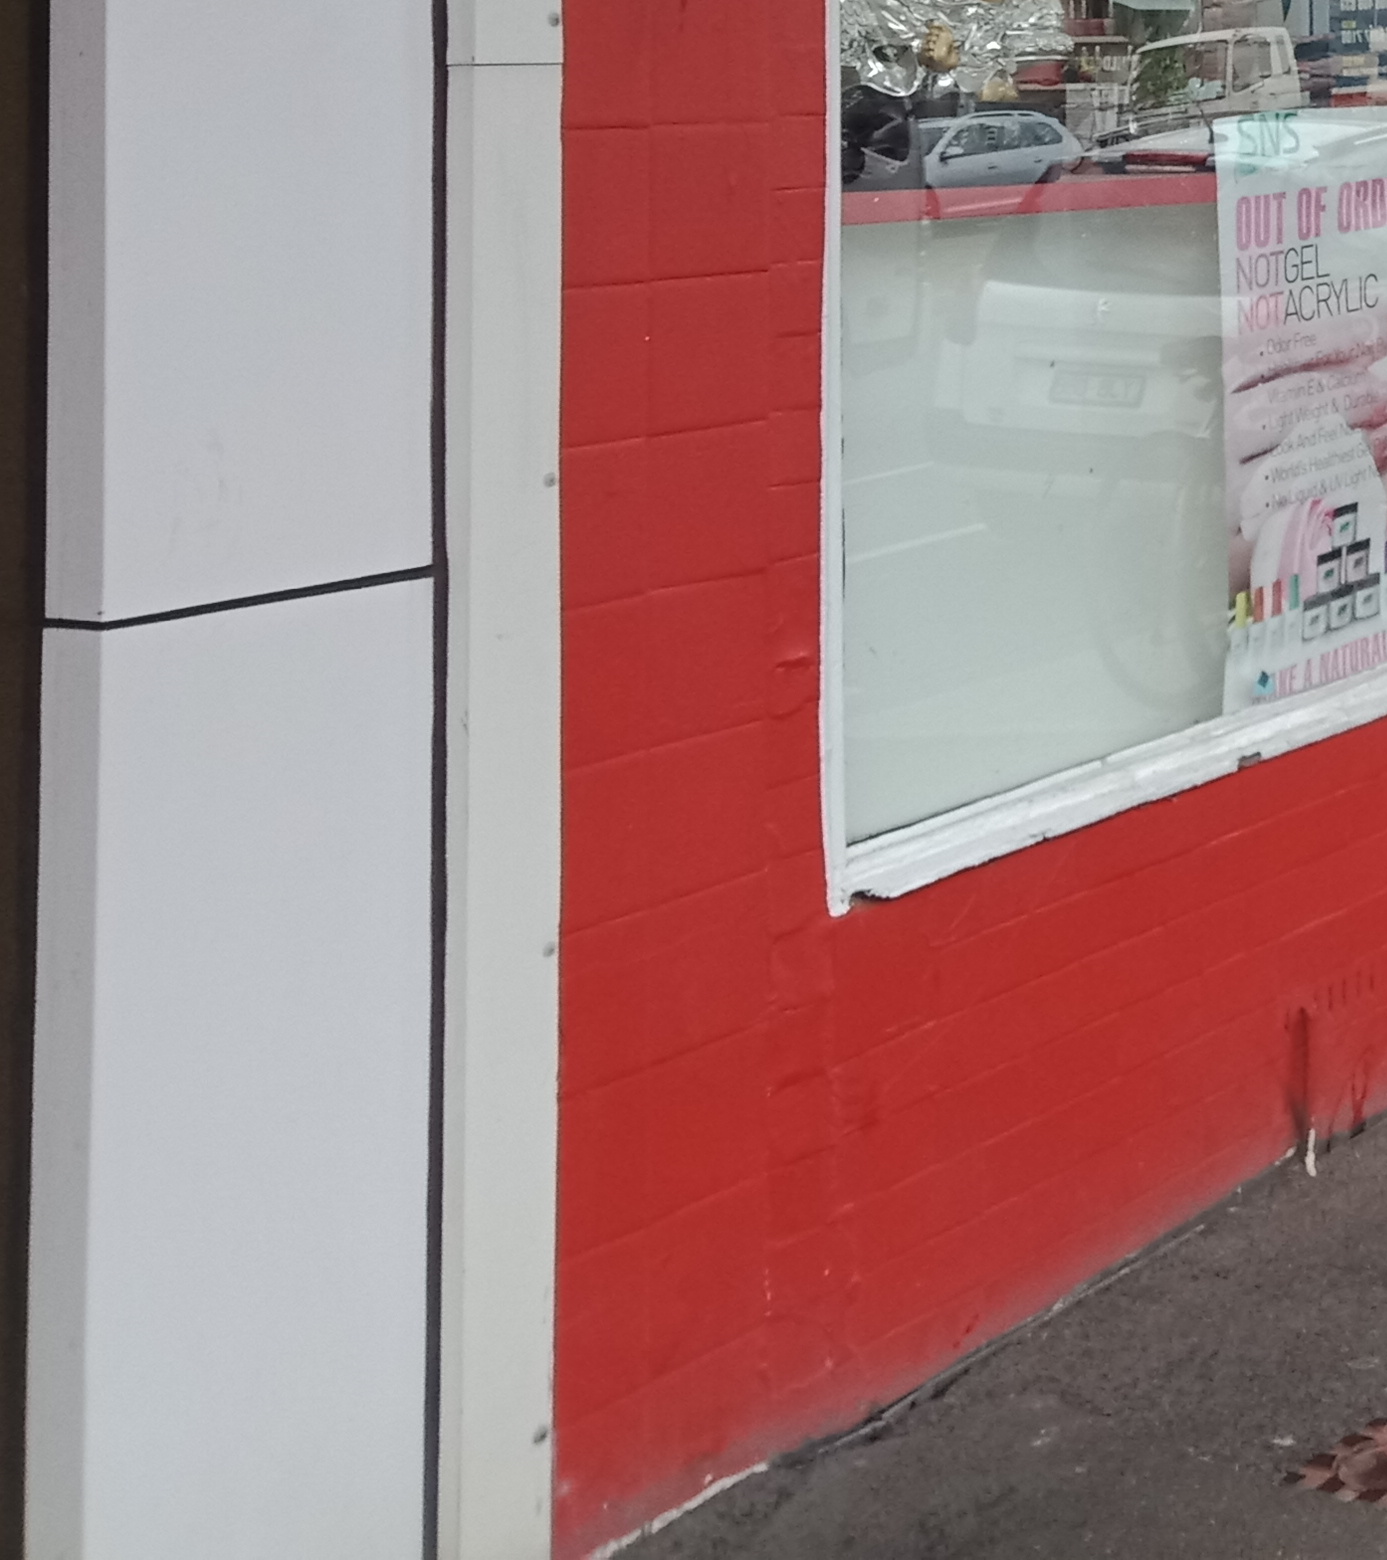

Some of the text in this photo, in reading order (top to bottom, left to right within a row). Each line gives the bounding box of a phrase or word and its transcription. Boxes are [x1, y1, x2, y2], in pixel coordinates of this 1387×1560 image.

[1236, 112, 1300, 157] SNS
[1236, 192, 1286, 251] OUT
[1297, 186, 1328, 240] OF
